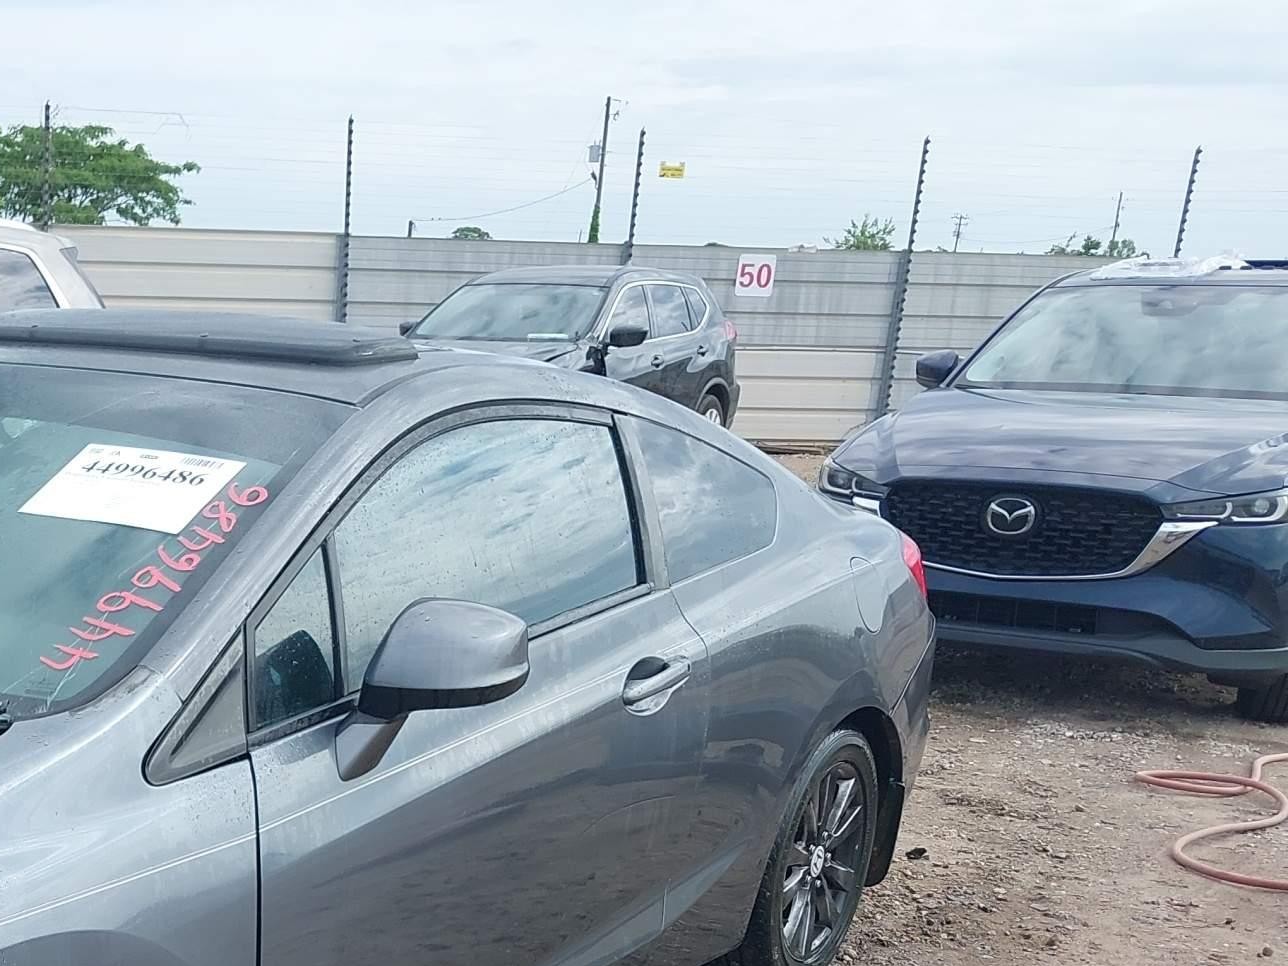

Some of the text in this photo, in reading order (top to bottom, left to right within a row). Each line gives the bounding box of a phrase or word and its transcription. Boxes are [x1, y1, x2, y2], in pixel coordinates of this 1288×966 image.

[739, 263, 772, 288] 50
[81, 460, 209, 487] 44996486
[39, 482, 269, 671] 44996486
